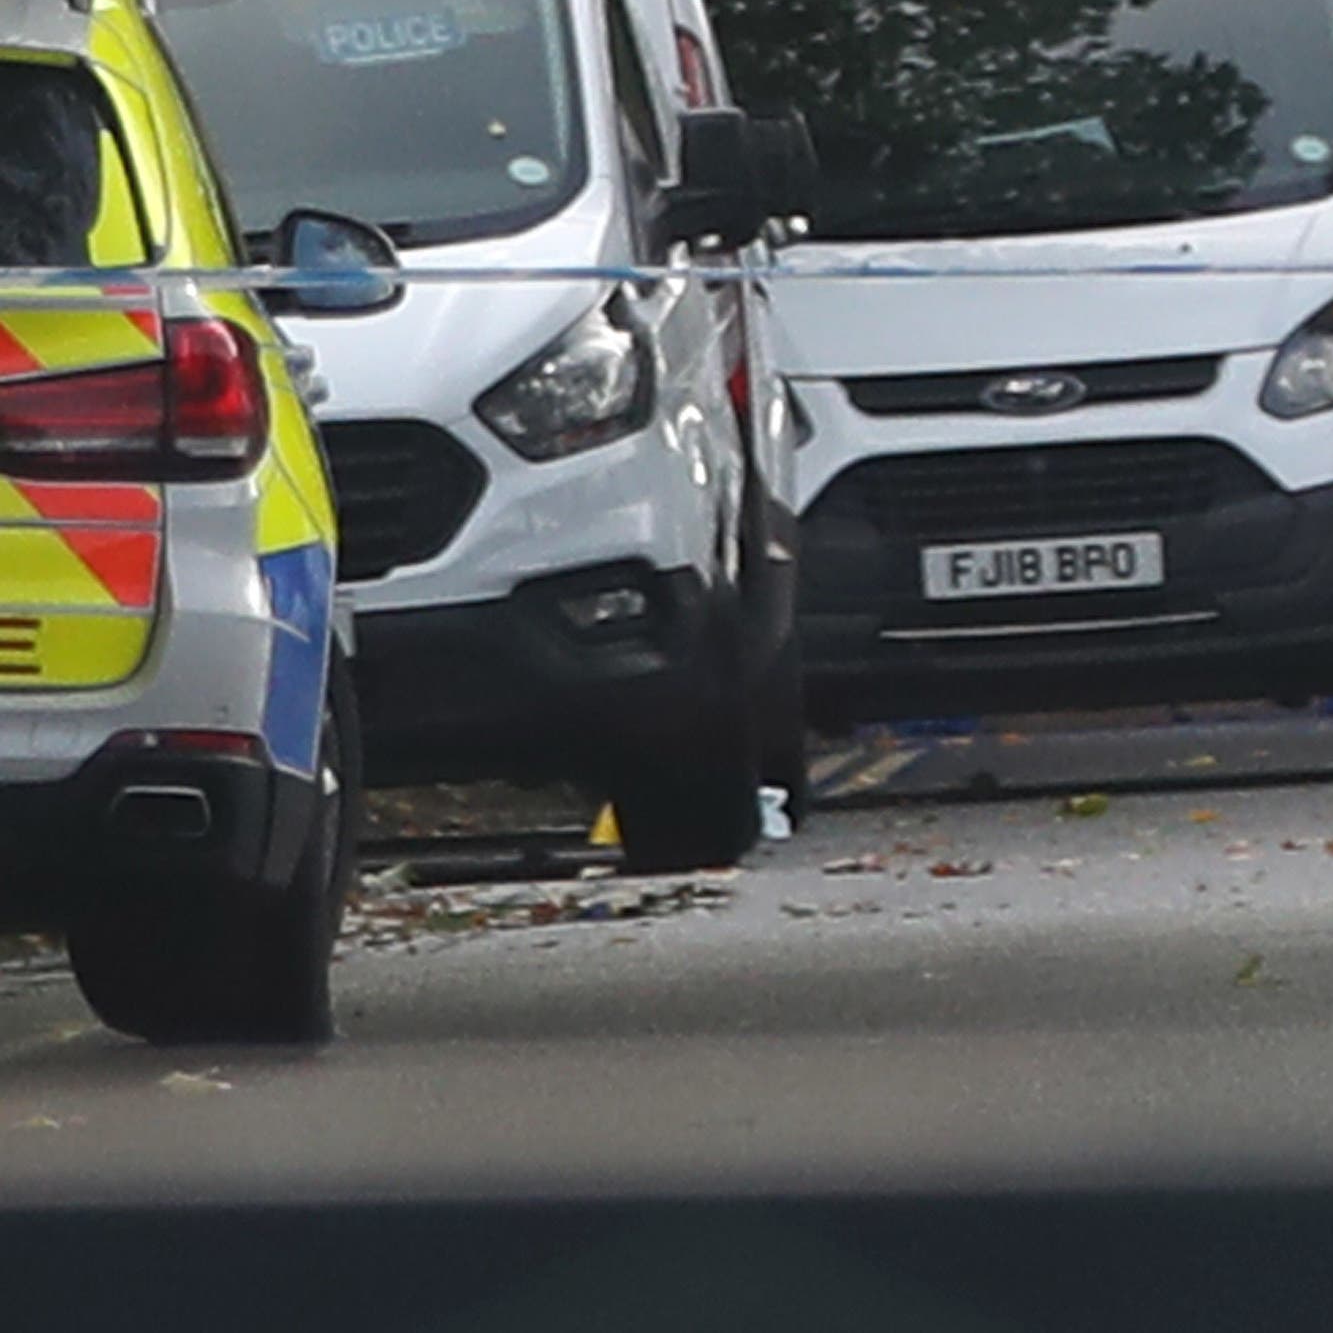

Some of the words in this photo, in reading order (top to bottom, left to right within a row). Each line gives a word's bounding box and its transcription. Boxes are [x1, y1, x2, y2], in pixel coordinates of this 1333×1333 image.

[324, 14, 451, 54] POLICE
[949, 547, 1042, 589] FJ18
[1055, 541, 1136, 583] BPO
